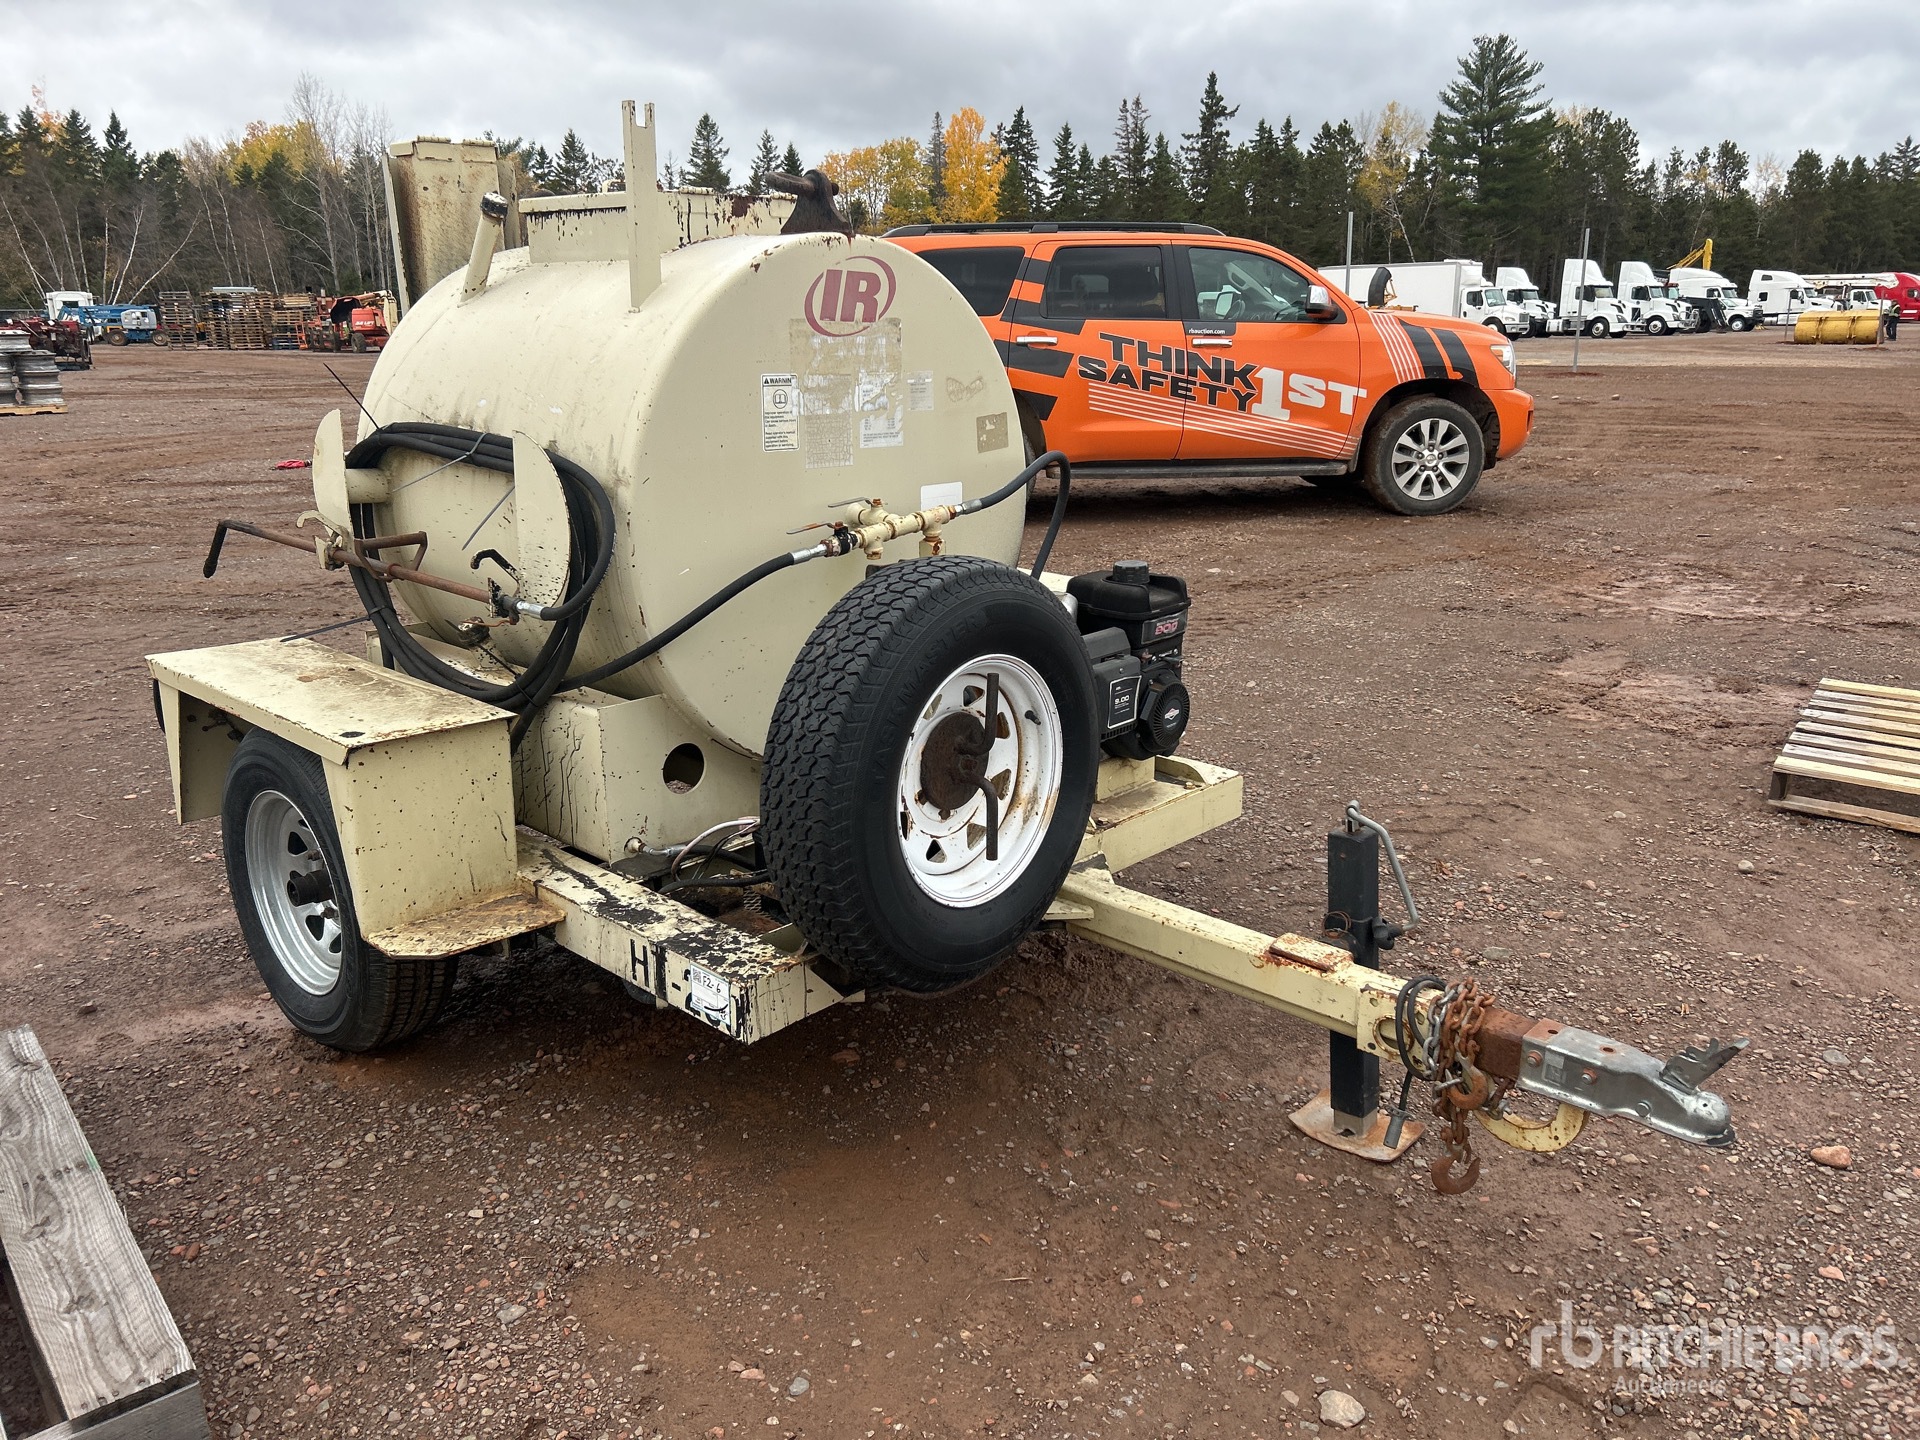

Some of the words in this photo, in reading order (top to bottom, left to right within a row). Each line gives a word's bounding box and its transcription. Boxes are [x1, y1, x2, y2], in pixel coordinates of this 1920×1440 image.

[820, 269, 881, 323] IR
[769, 377, 795, 385] WARNIN
[1077, 355, 1258, 413] SAFETY
[1099, 331, 1260, 391] THINK
[1251, 367, 1368, 421] 1ST
